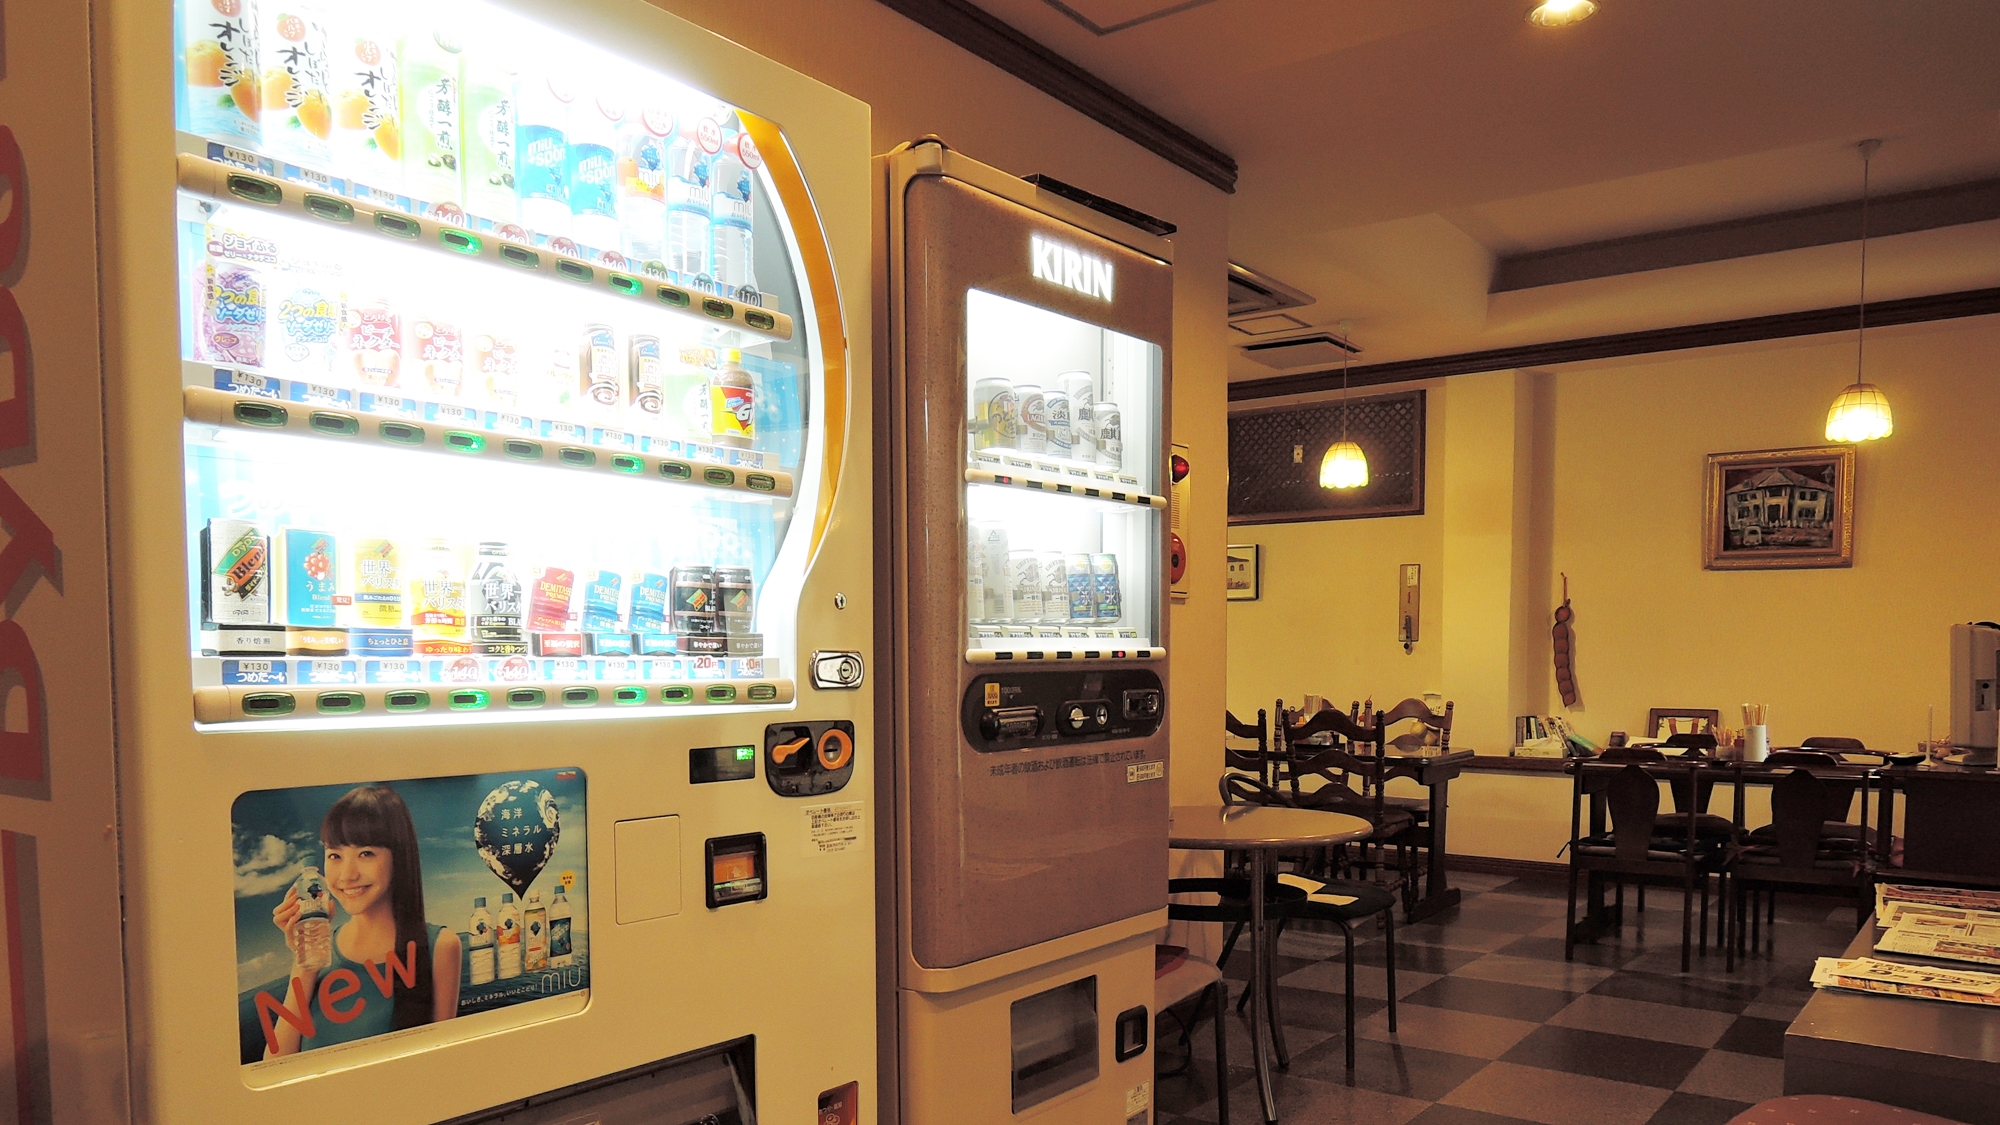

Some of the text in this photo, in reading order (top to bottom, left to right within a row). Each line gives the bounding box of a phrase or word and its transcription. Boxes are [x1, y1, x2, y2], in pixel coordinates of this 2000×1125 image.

[208, 21, 242, 87] オレンジ
[276, 46, 309, 108] オレンジ
[354, 70, 385, 130] オレンジ
[435, 78, 453, 150] 芳醇一煎
[228, 150, 254, 163] ¥130
[304, 169, 328, 183] ¥130
[225, 235, 277, 253] ジョイふる
[1032, 236, 1112, 302] KIRIN
[362, 326, 393, 336] ピーチ
[352, 335, 399, 348] ネクター
[237, 370, 262, 386] ¥130
[311, 384, 335, 397] ¥130
[378, 396, 400, 406] ¥130
[440, 407, 462, 416] ¥130
[501, 414, 519, 425] ¥130
[554, 424, 573, 432] ¥130
[605, 431, 622, 441] ¥130
[652, 438, 669, 447] ¥130
[698, 446, 714, 454] ¥130
[741, 452, 755, 460] ¥130
[305, 580, 334, 592] うまみ
[484, 583, 522, 600] 世界一
[236, 637, 271, 645] 香り焙煎
[243, 663, 269, 671] ¥130
[317, 662, 340, 671] ¥130
[383, 662, 405, 671] ¥130
[607, 661, 625, 669] ¥130
[501, 808, 523, 820] 海洋
[501, 825, 542, 838] ミネラル
[501, 842, 534, 856] 深層水
[254, 941, 417, 1055] New
